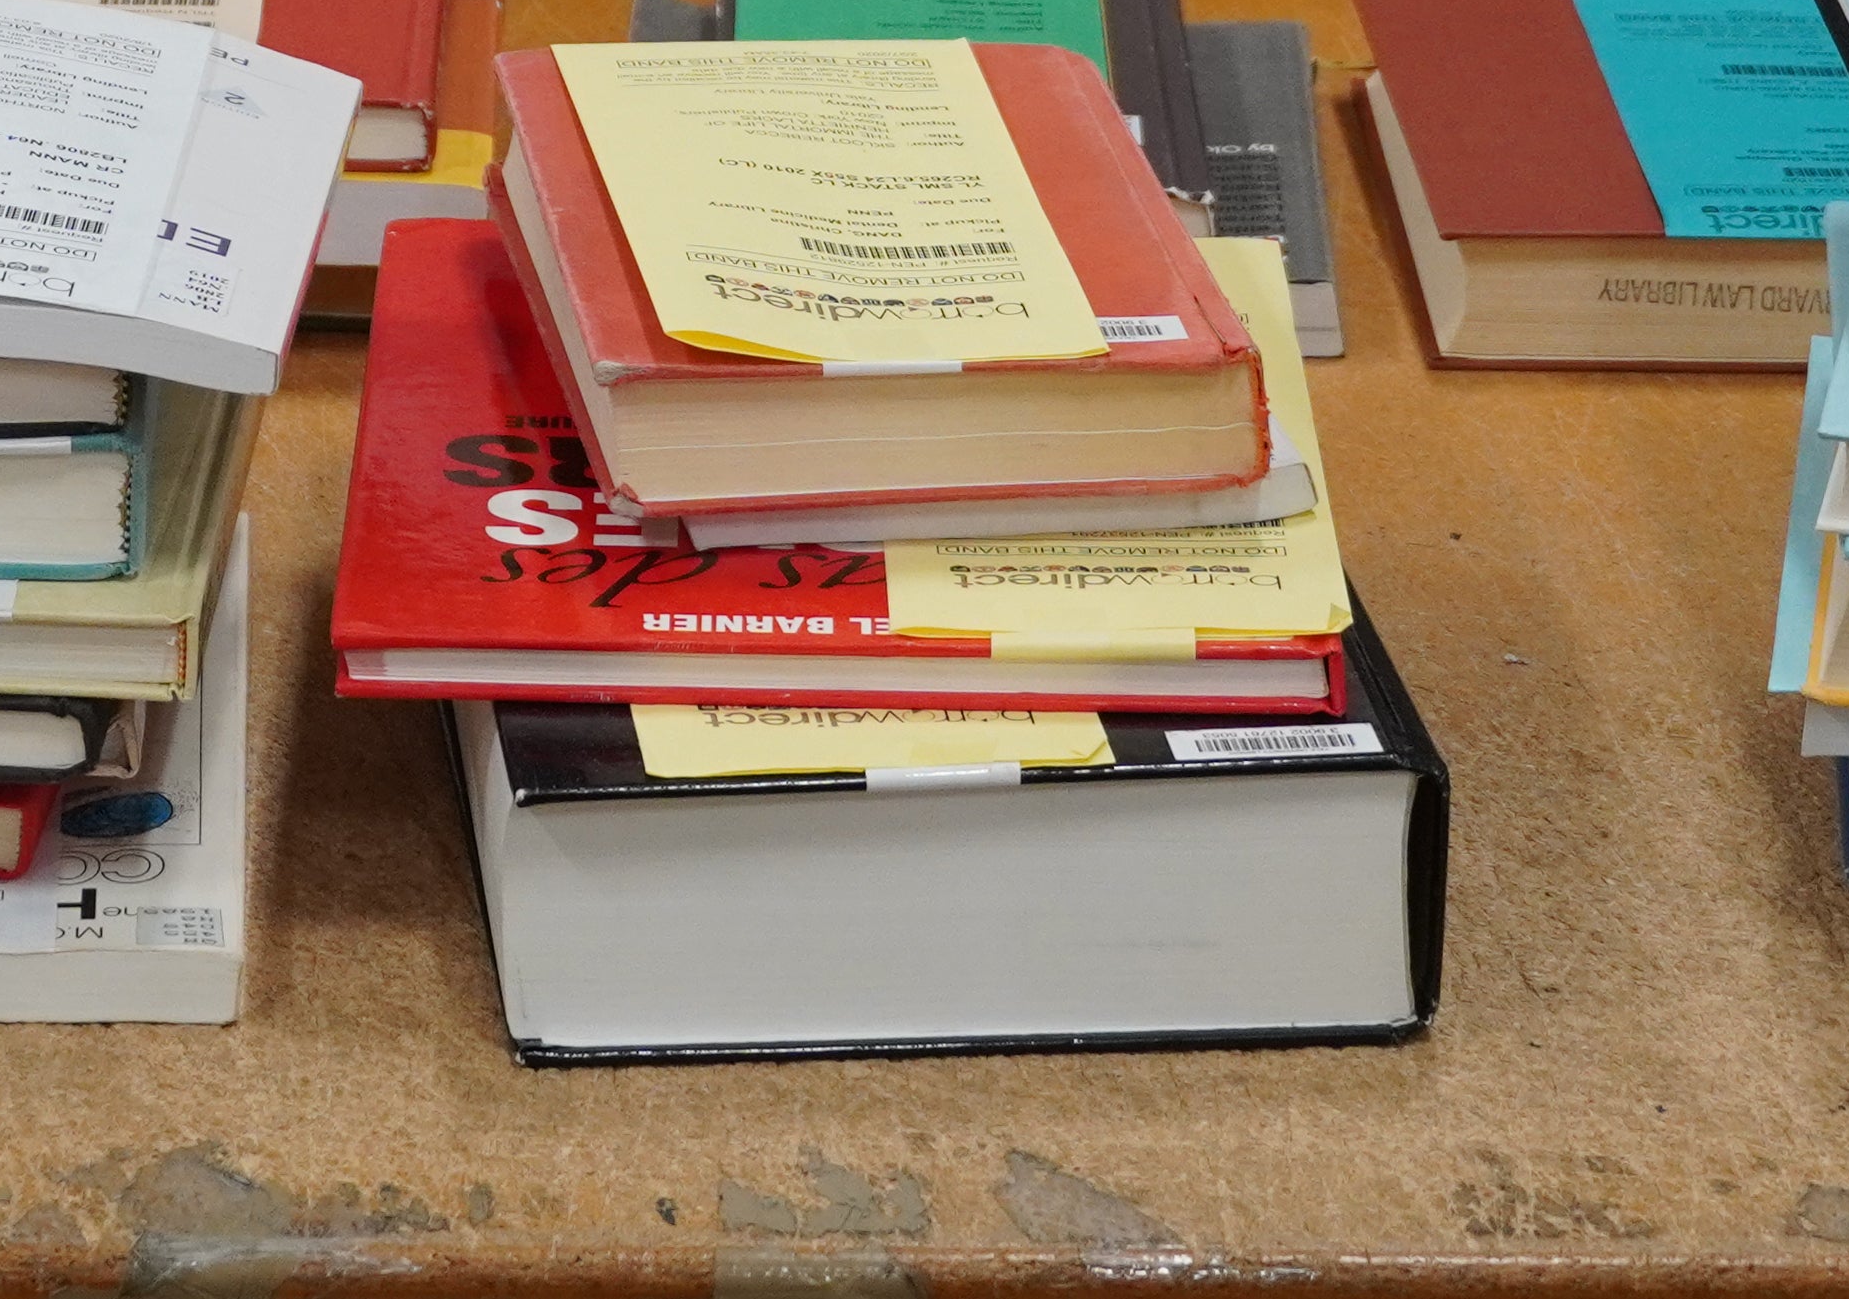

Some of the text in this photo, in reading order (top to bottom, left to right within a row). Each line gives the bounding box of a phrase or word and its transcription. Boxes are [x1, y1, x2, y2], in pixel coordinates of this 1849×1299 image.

[224, 92, 245, 105] 2
[29, 151, 125, 174] CR MANN
[87, 179, 120, 189] Due
[842, 180, 907, 190] STACK
[847, 208, 894, 217] PENN
[845, 218, 898, 229] Dental
[0, 238, 45, 250] NOT
[54, 247, 88, 258] DO
[694, 252, 1017, 286] DO NOT REMOVE THIS BAND
[1598, 279, 1754, 309] LAW LIBRARY
[710, 284, 1029, 321] borrowdirect
[944, 546, 1009, 555] BAND
[1018, 546, 1068, 555] THIS
[480, 548, 718, 608] des
[953, 572, 1282, 589] borrowdirect
[642, 613, 833, 634] BARNIER
